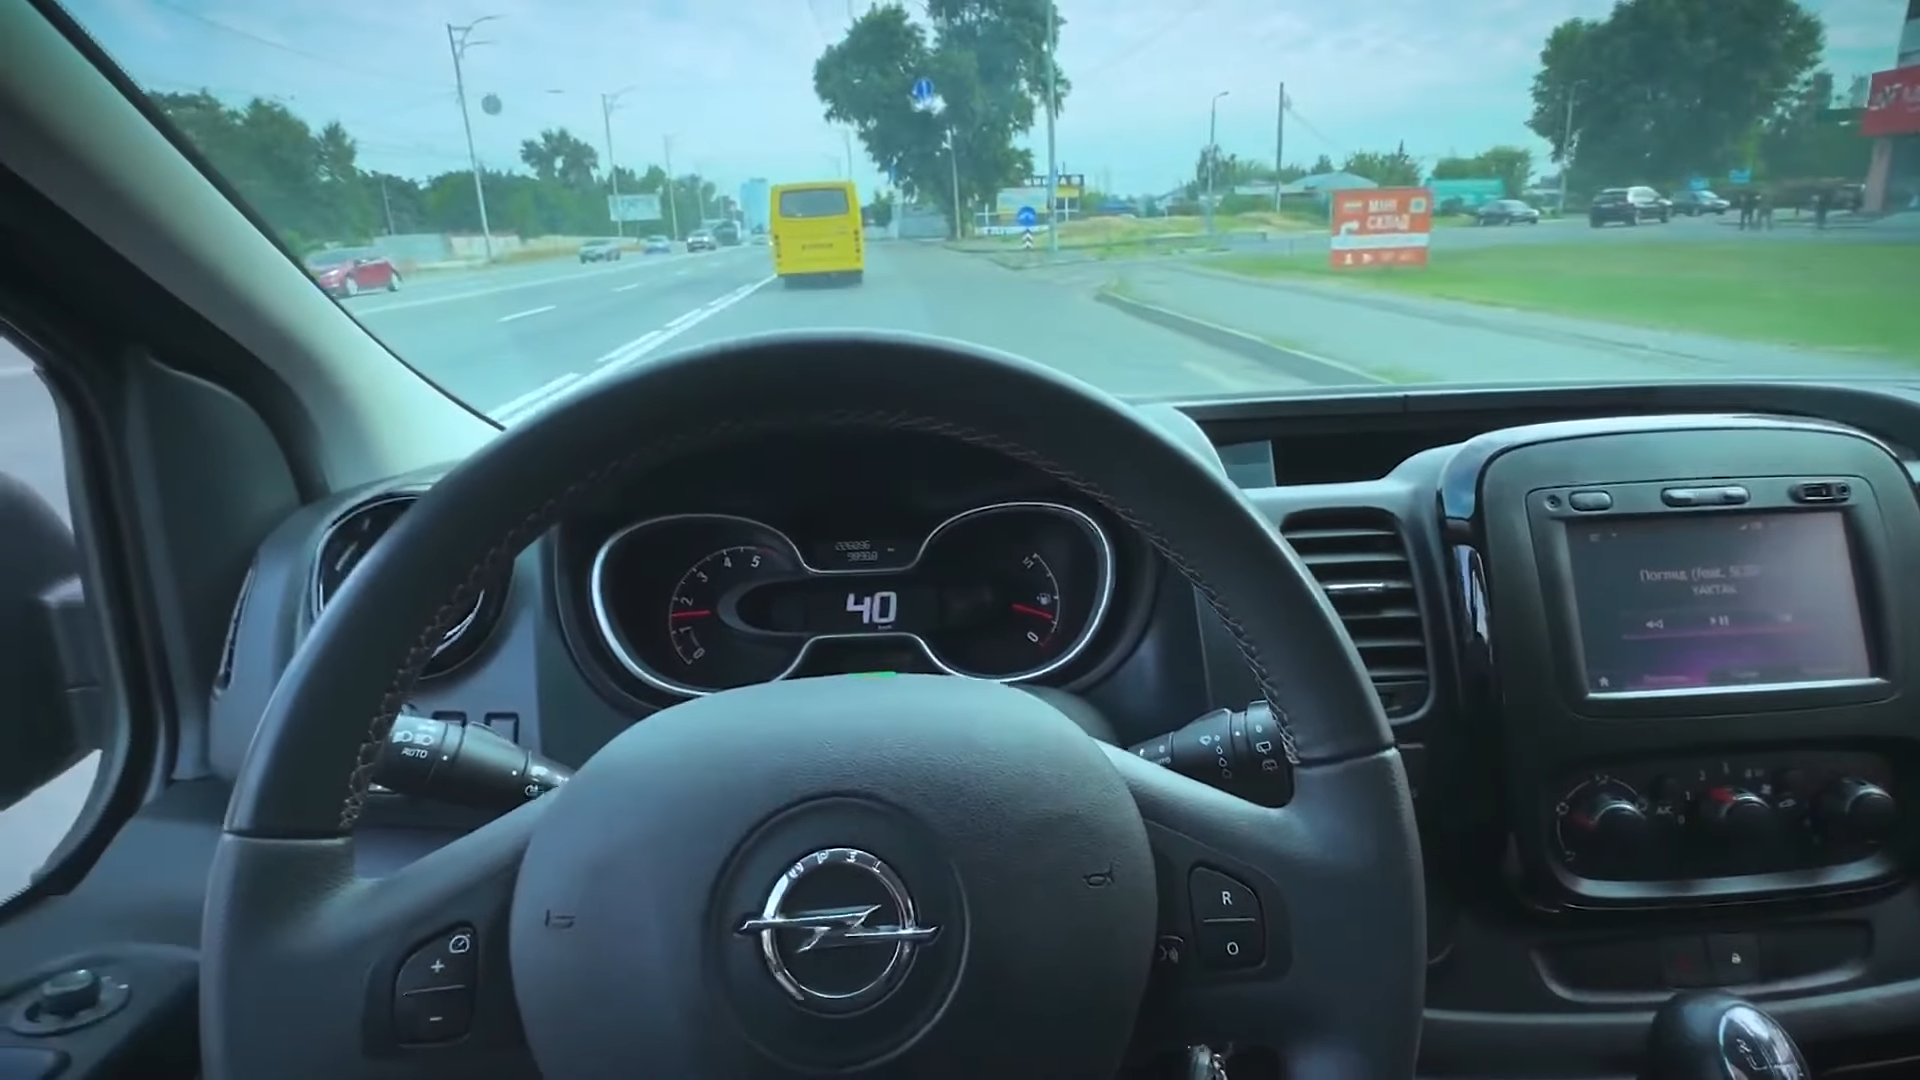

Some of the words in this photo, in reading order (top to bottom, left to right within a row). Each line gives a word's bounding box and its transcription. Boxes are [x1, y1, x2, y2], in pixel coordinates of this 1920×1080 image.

[750, 555, 761, 568] 5
[680, 596, 694, 607] 2
[846, 591, 897, 624] 40
[1026, 631, 1039, 643] 0
[693, 647, 706, 660] 0
[402, 747, 428, 759] AUTO
[1221, 890, 1233, 906] R
